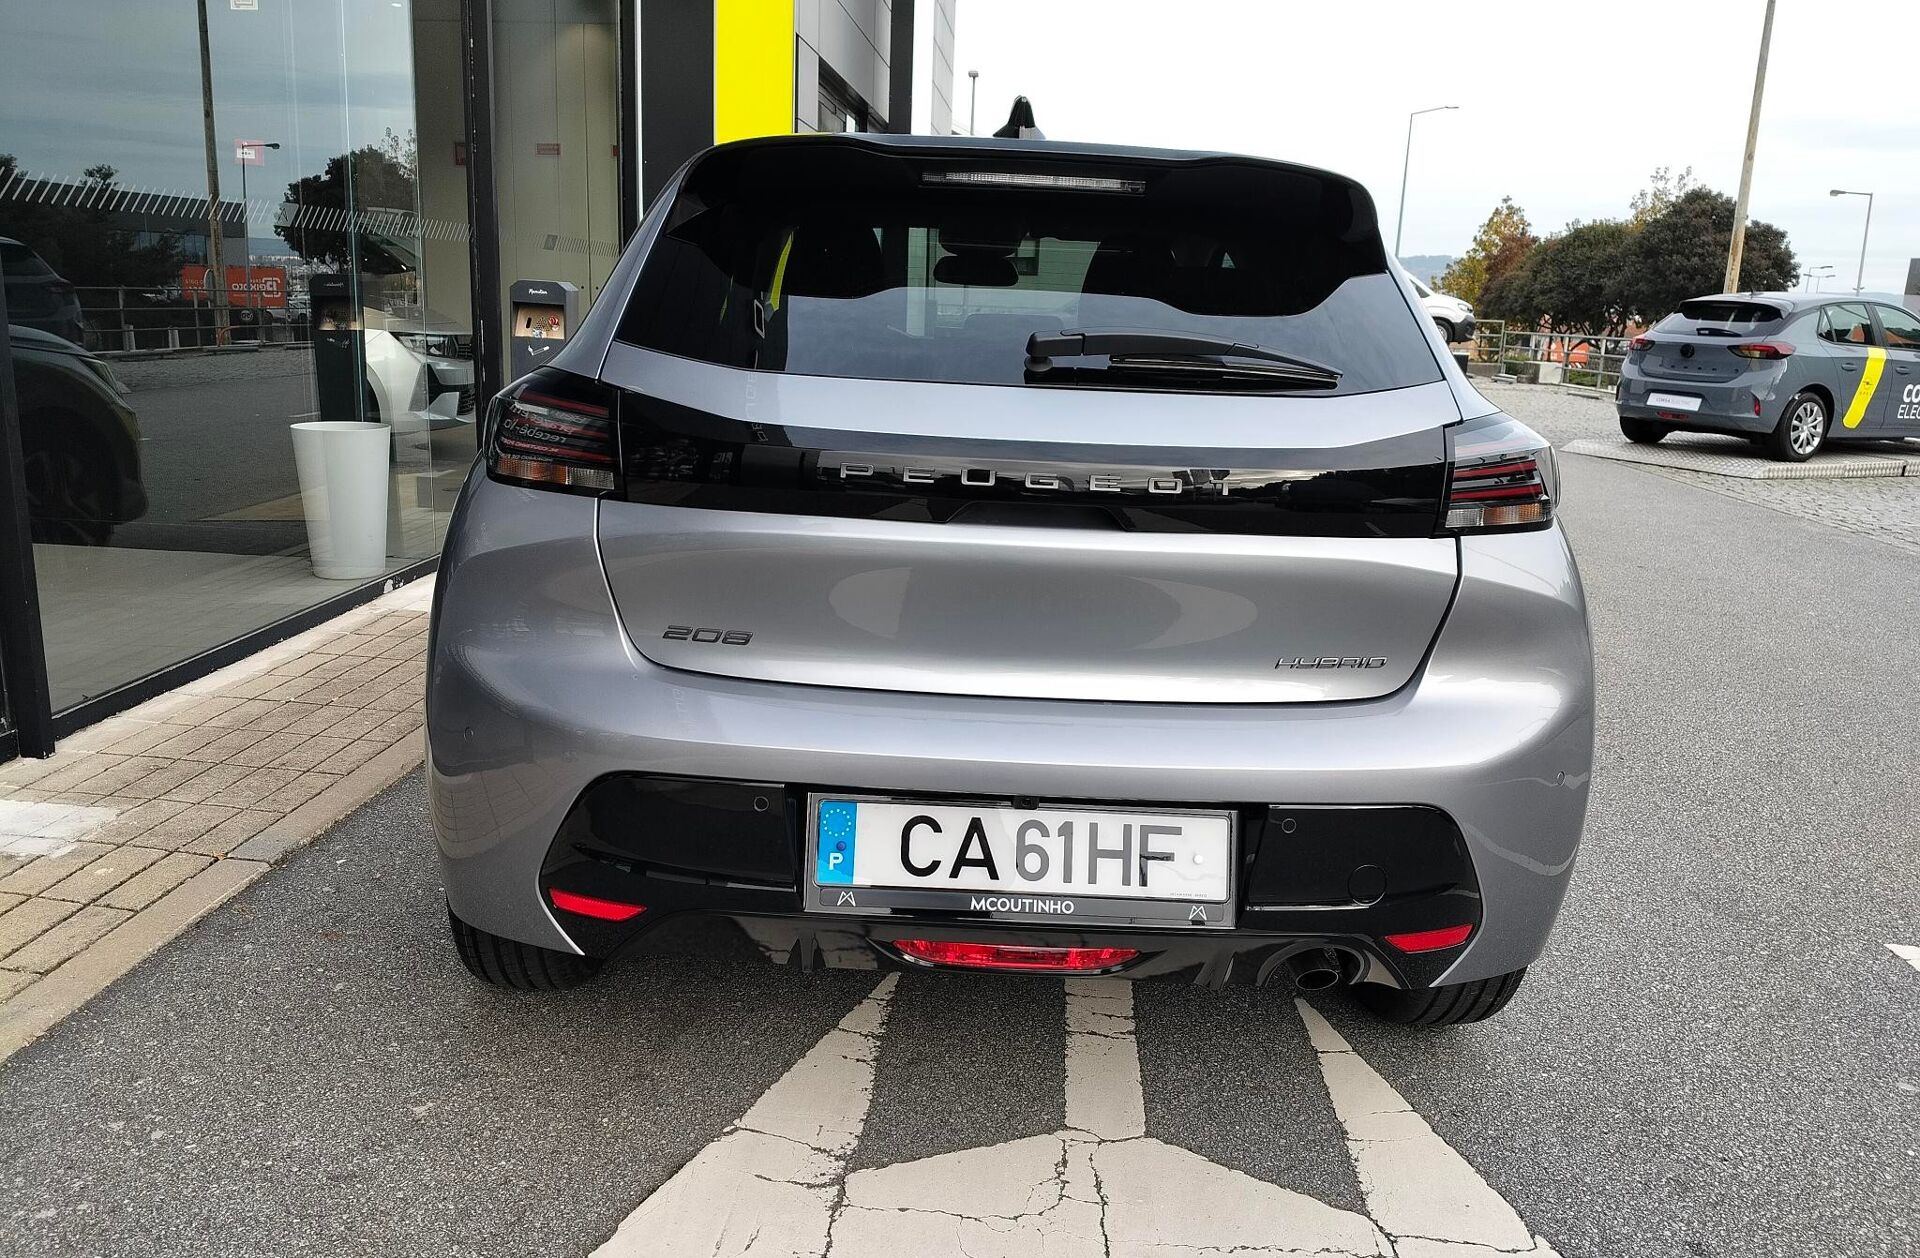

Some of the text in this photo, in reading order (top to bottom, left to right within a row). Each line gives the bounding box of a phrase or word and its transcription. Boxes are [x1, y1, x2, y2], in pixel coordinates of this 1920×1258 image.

[840, 462, 1241, 496] PEUGEOT
[662, 624, 753, 646] 208
[1274, 656, 1388, 669] HYBRID
[829, 852, 844, 871] P
[970, 895, 1075, 915] MCOUTINHO
